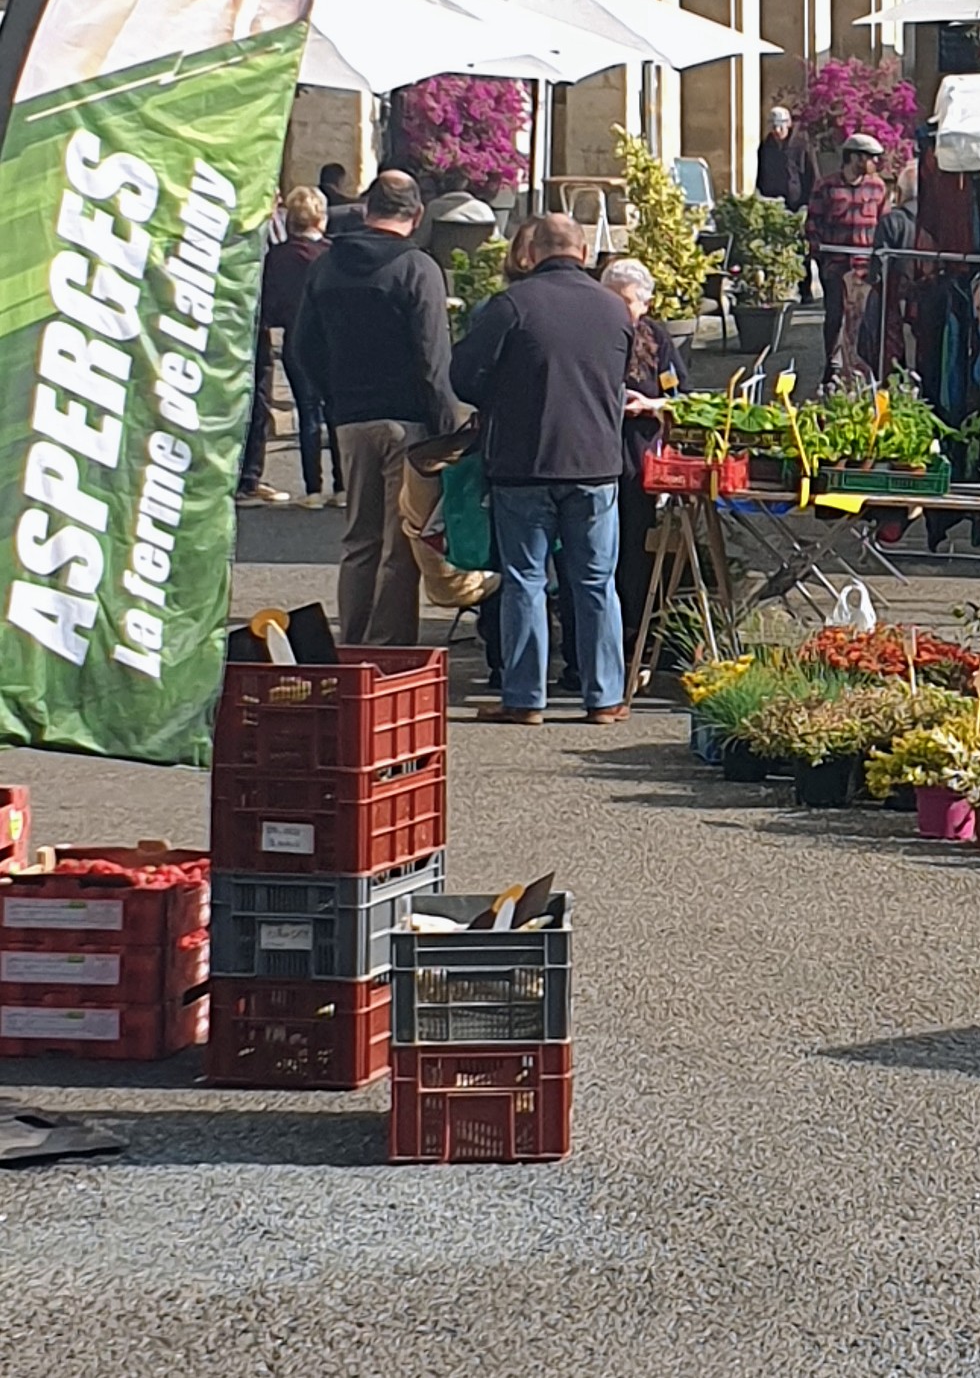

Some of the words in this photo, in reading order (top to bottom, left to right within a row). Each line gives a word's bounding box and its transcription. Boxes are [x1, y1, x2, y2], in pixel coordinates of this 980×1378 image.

[7, 128, 160, 667] ASPERGES
[154, 351, 204, 431] de
[123, 430, 192, 608] ferme
[113, 608, 163, 678] La
